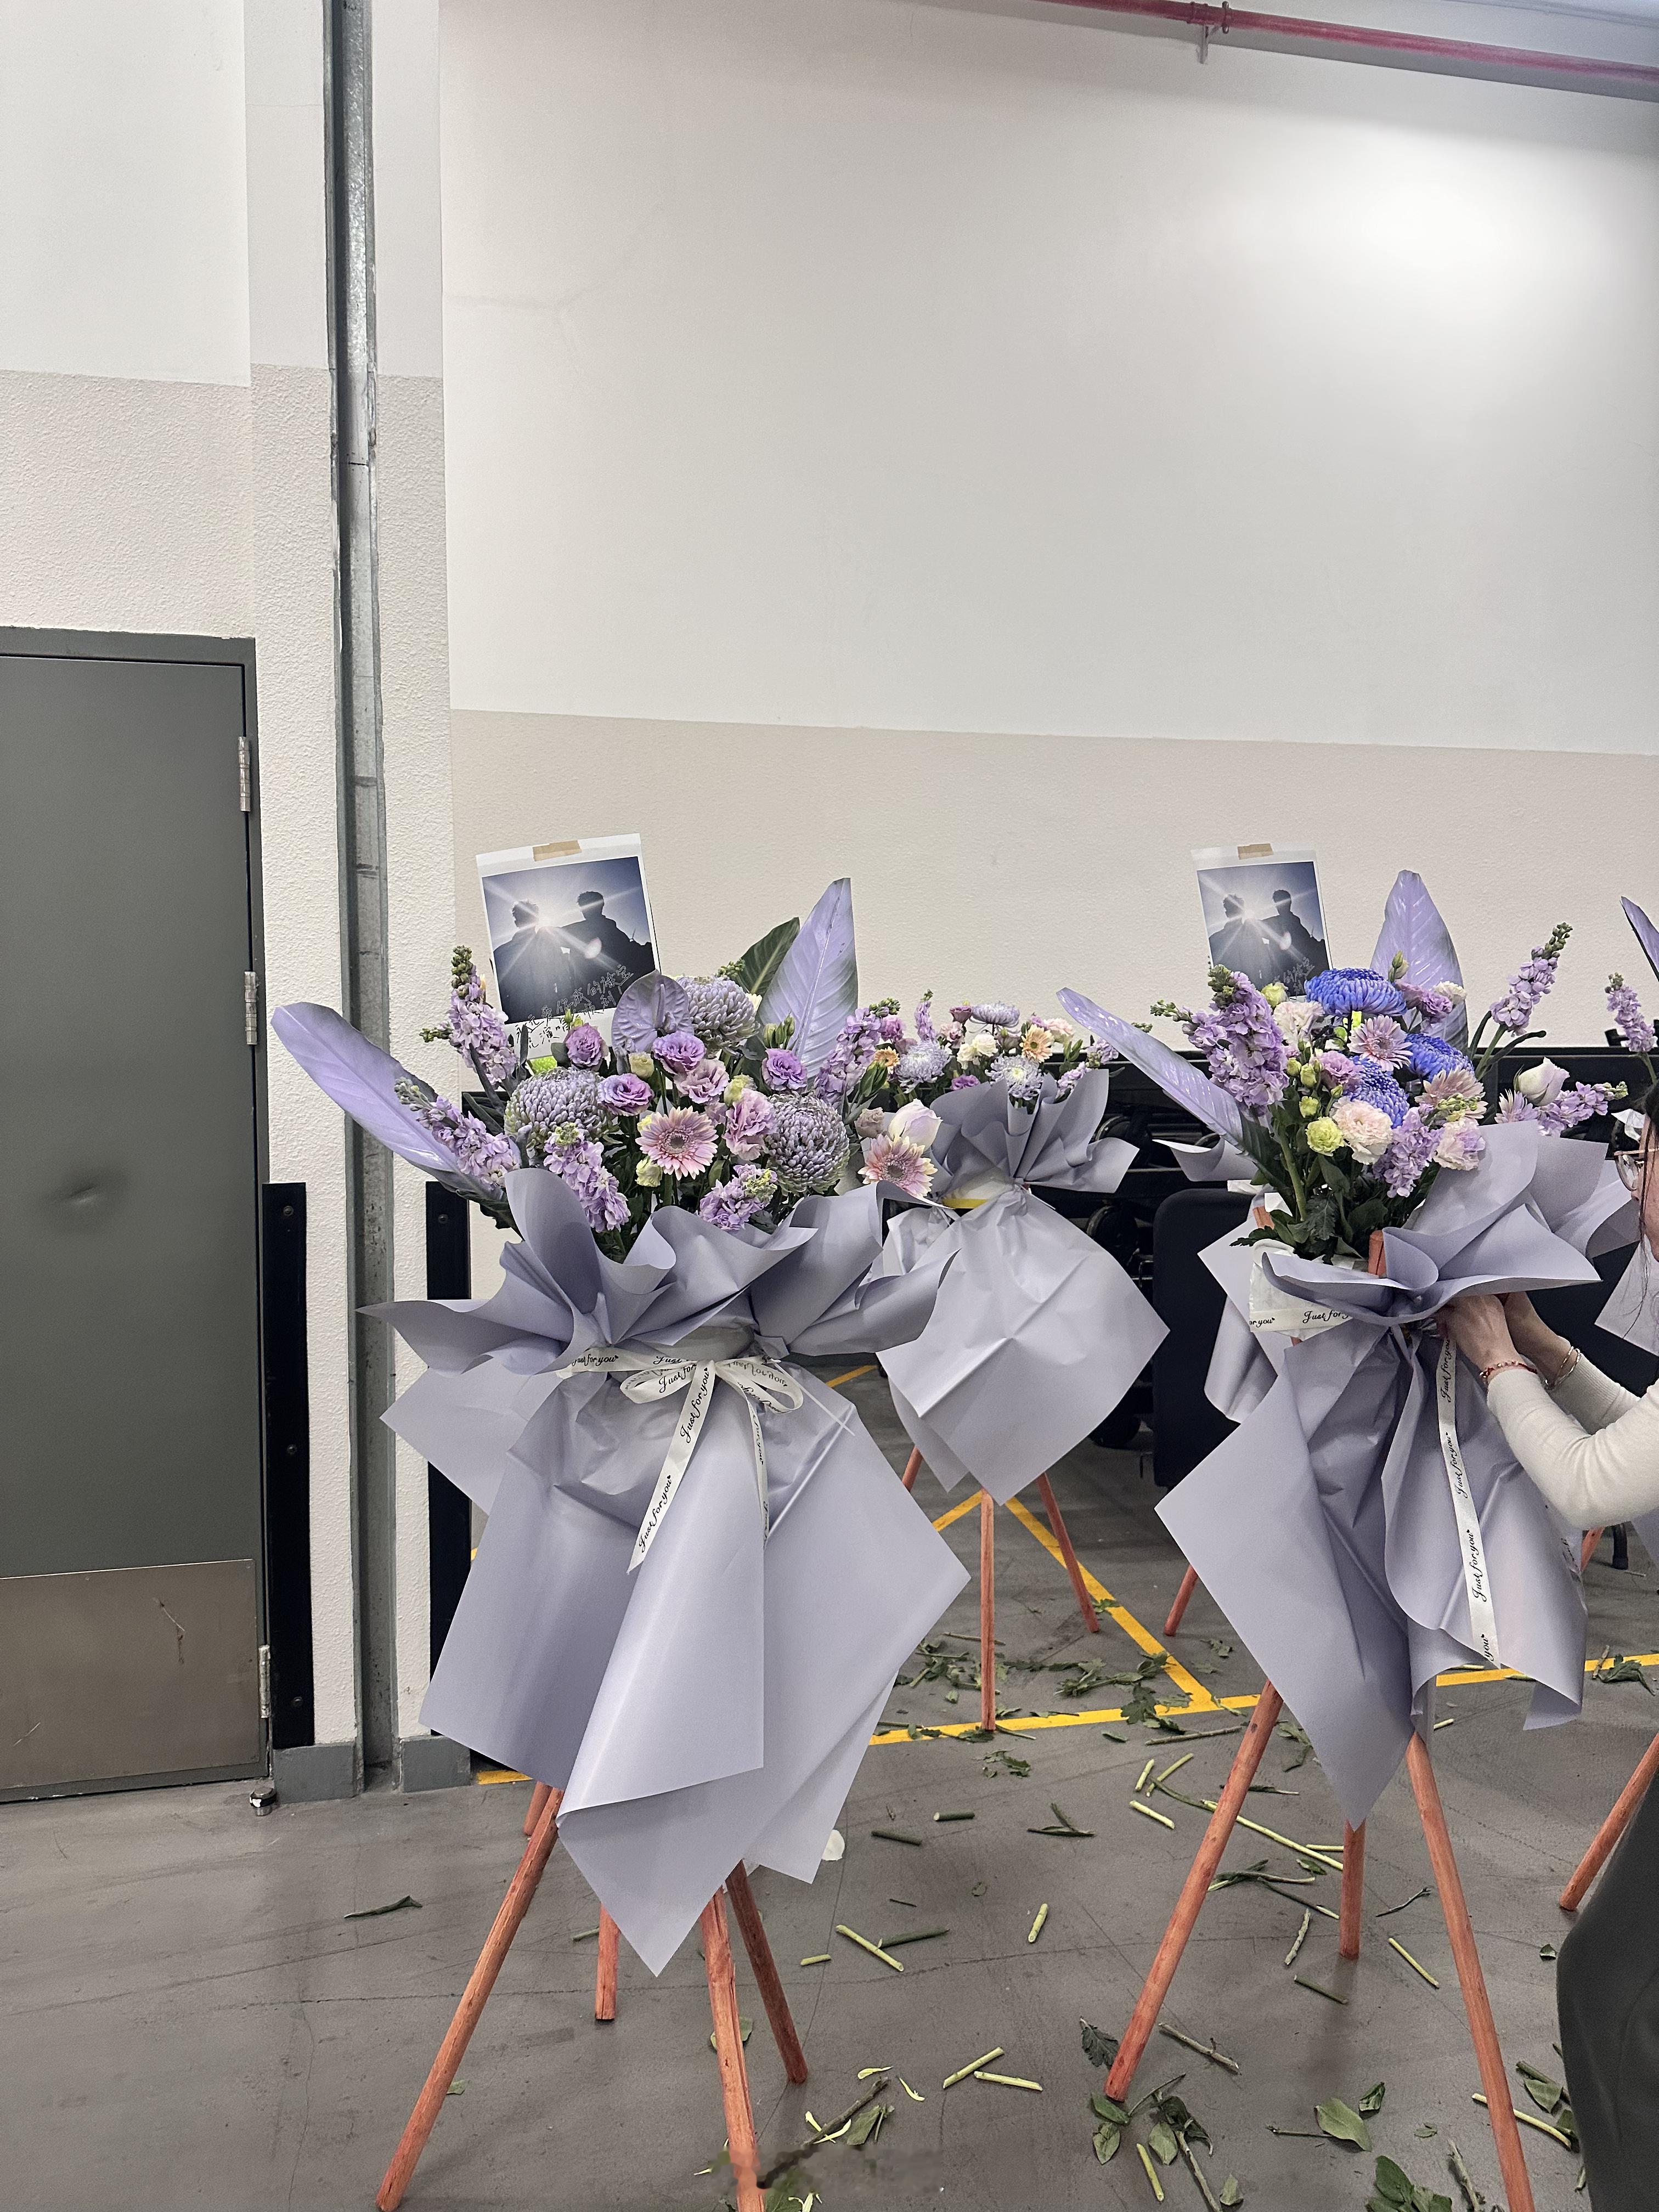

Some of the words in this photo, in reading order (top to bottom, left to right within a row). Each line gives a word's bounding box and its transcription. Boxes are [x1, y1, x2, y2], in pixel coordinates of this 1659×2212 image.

[1256, 1319, 1273, 1328] you
[1302, 1311, 1325, 1324] Just
[1324, 1309, 1342, 1322] for
[584, 1353, 596, 1366] for
[595, 1357, 615, 1366] you
[1441, 1357, 1452, 1380] for
[658, 1372, 682, 1393] Just
[680, 1363, 697, 1380] for
[1440, 1375, 1451, 1403] Just
[680, 1412, 697, 1444] Just
[691, 1392, 703, 1419] for
[700, 1371, 710, 1396] you
[1447, 1436, 1458, 1457] you
[1450, 1454, 1463, 1476] for
[1454, 1471, 1468, 1499] Just
[639, 1521, 654, 1553] Just
[652, 1499, 663, 1527] for
[661, 1480, 672, 1505] you
[1468, 1532, 1480, 1555] you
[1469, 1553, 1483, 1577] for
[1471, 1573, 1487, 1602] Just
[1483, 1638, 1494, 1662] you
